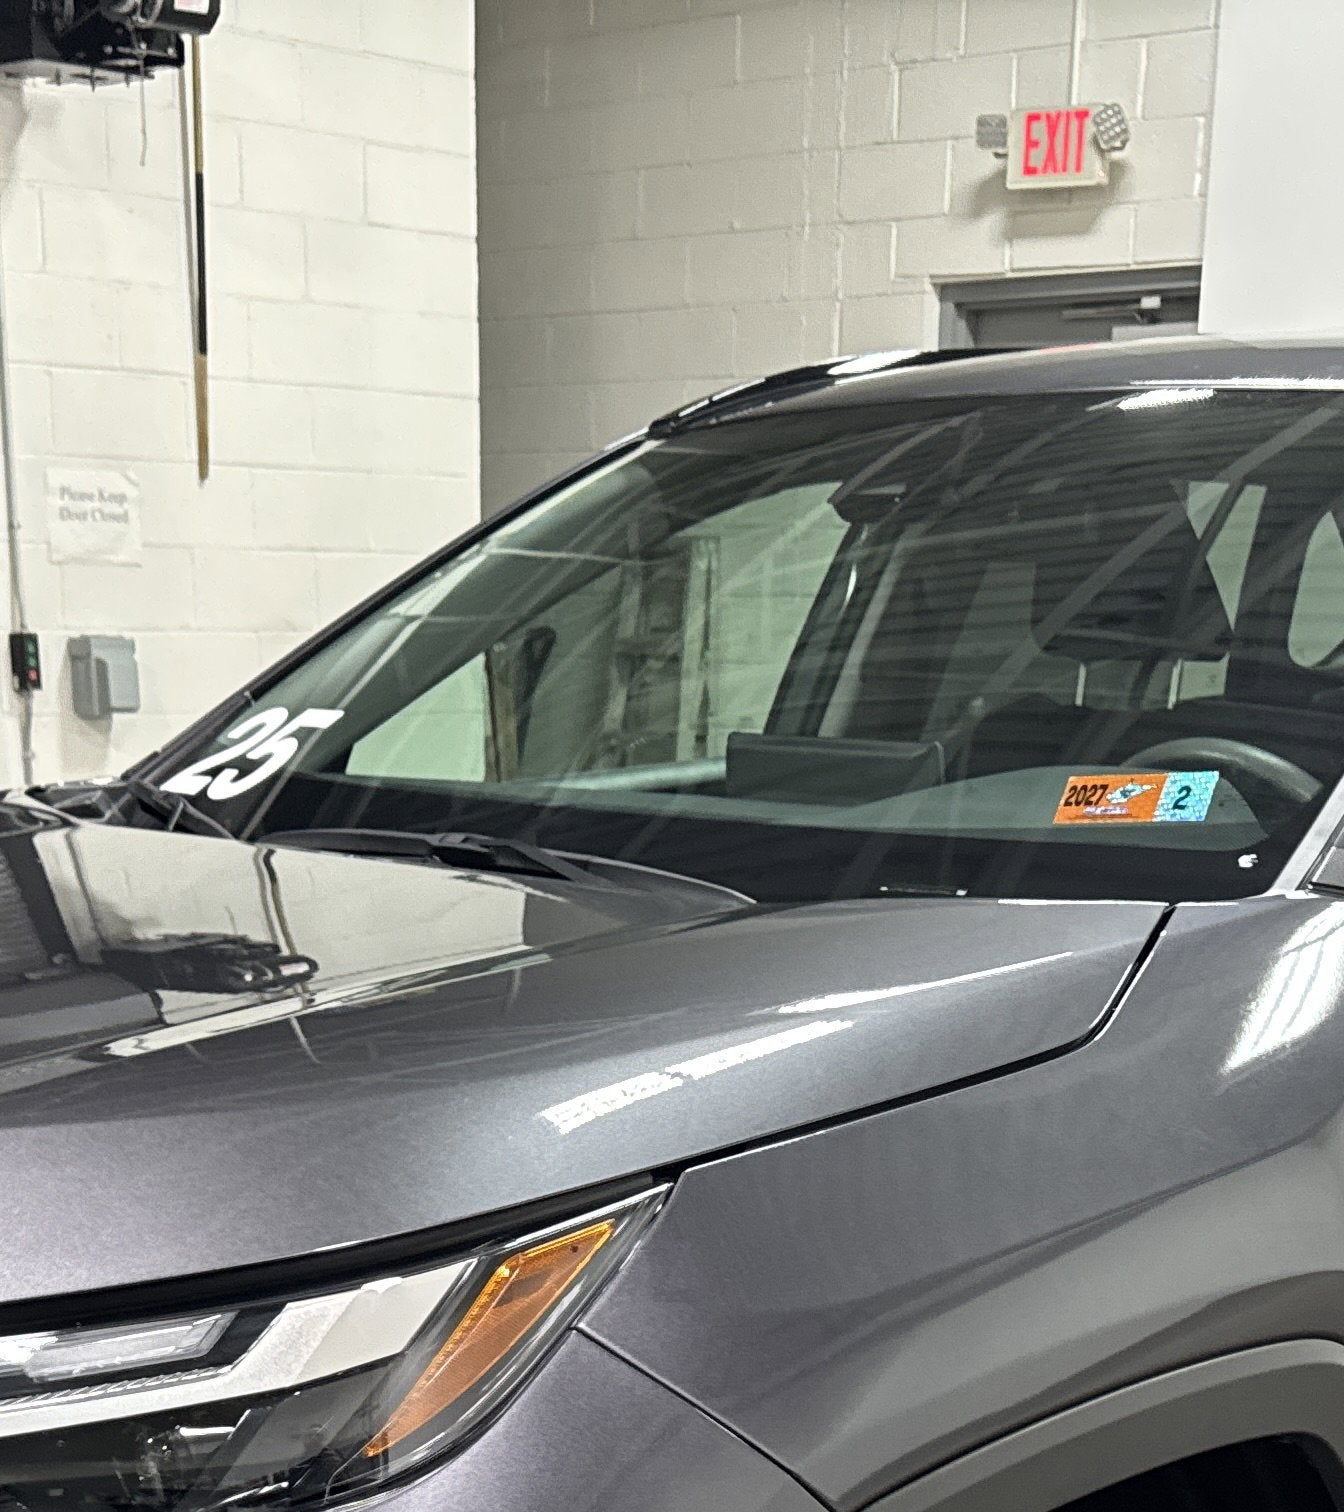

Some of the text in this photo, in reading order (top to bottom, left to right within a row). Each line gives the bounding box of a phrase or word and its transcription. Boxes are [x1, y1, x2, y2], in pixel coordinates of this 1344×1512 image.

[1022, 108, 1090, 176] EXIT
[158, 706, 345, 801] 25
[1063, 783, 1110, 808] 2027
[1172, 785, 1193, 811] 2
